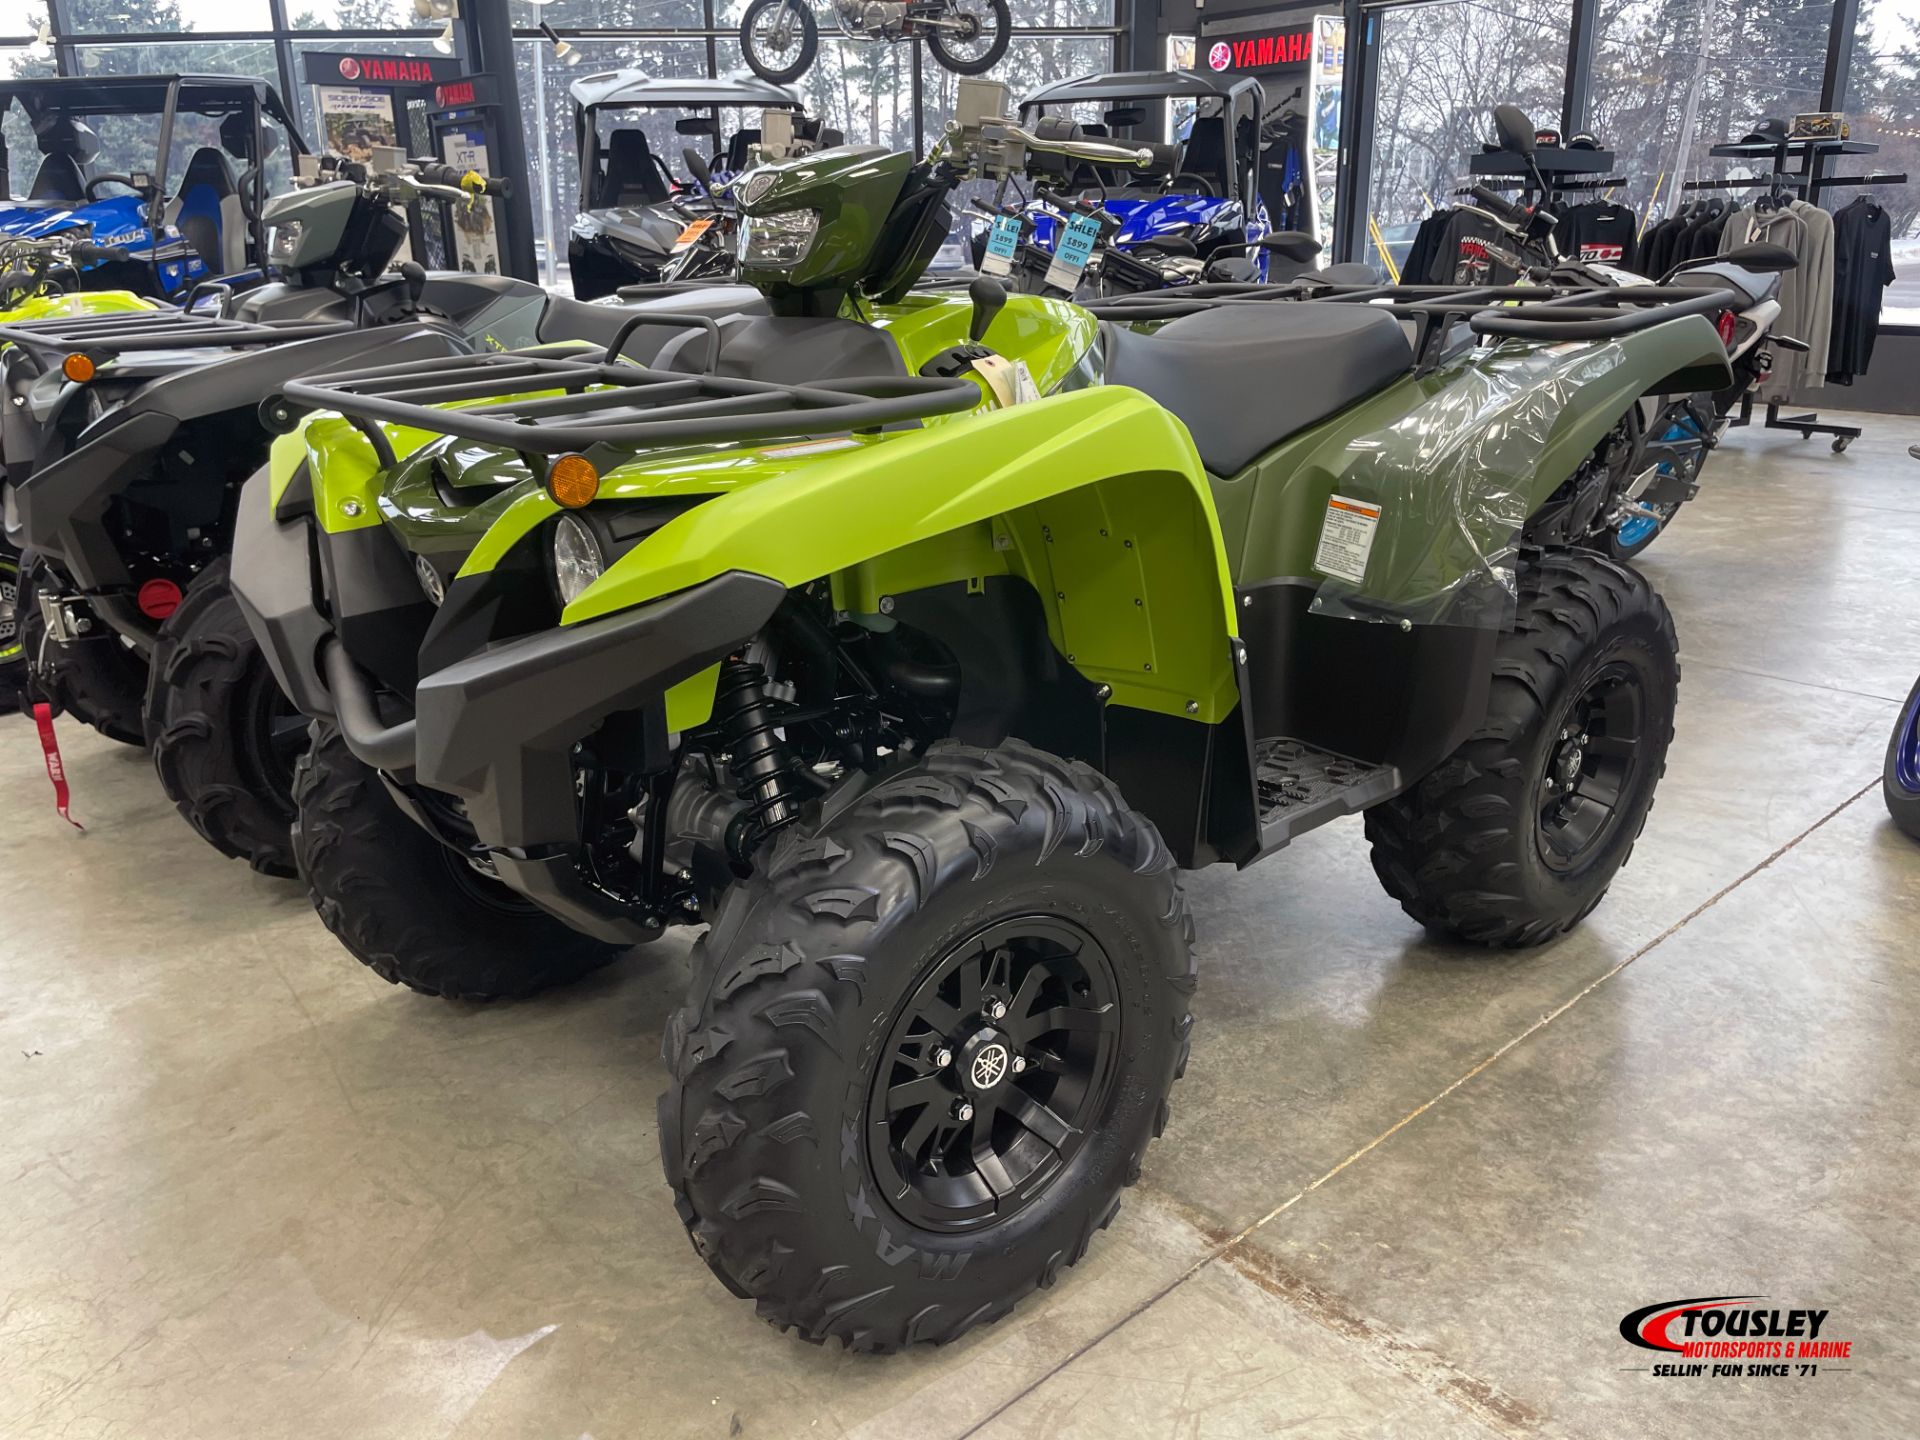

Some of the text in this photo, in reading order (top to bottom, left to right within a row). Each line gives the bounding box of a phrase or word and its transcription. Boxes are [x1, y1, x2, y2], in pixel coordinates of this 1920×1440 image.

[1232, 32, 1313, 69] YAMAHA
[360, 59, 433, 82] YAMAHA
[443, 82, 475, 106] YAMAHA
[996, 221, 1019, 234] SLE!
[1068, 220, 1097, 238] SALE!
[995, 233, 1013, 244] $899
[1066, 237, 1088, 251] $899
[1064, 252, 1080, 263] OFF!
